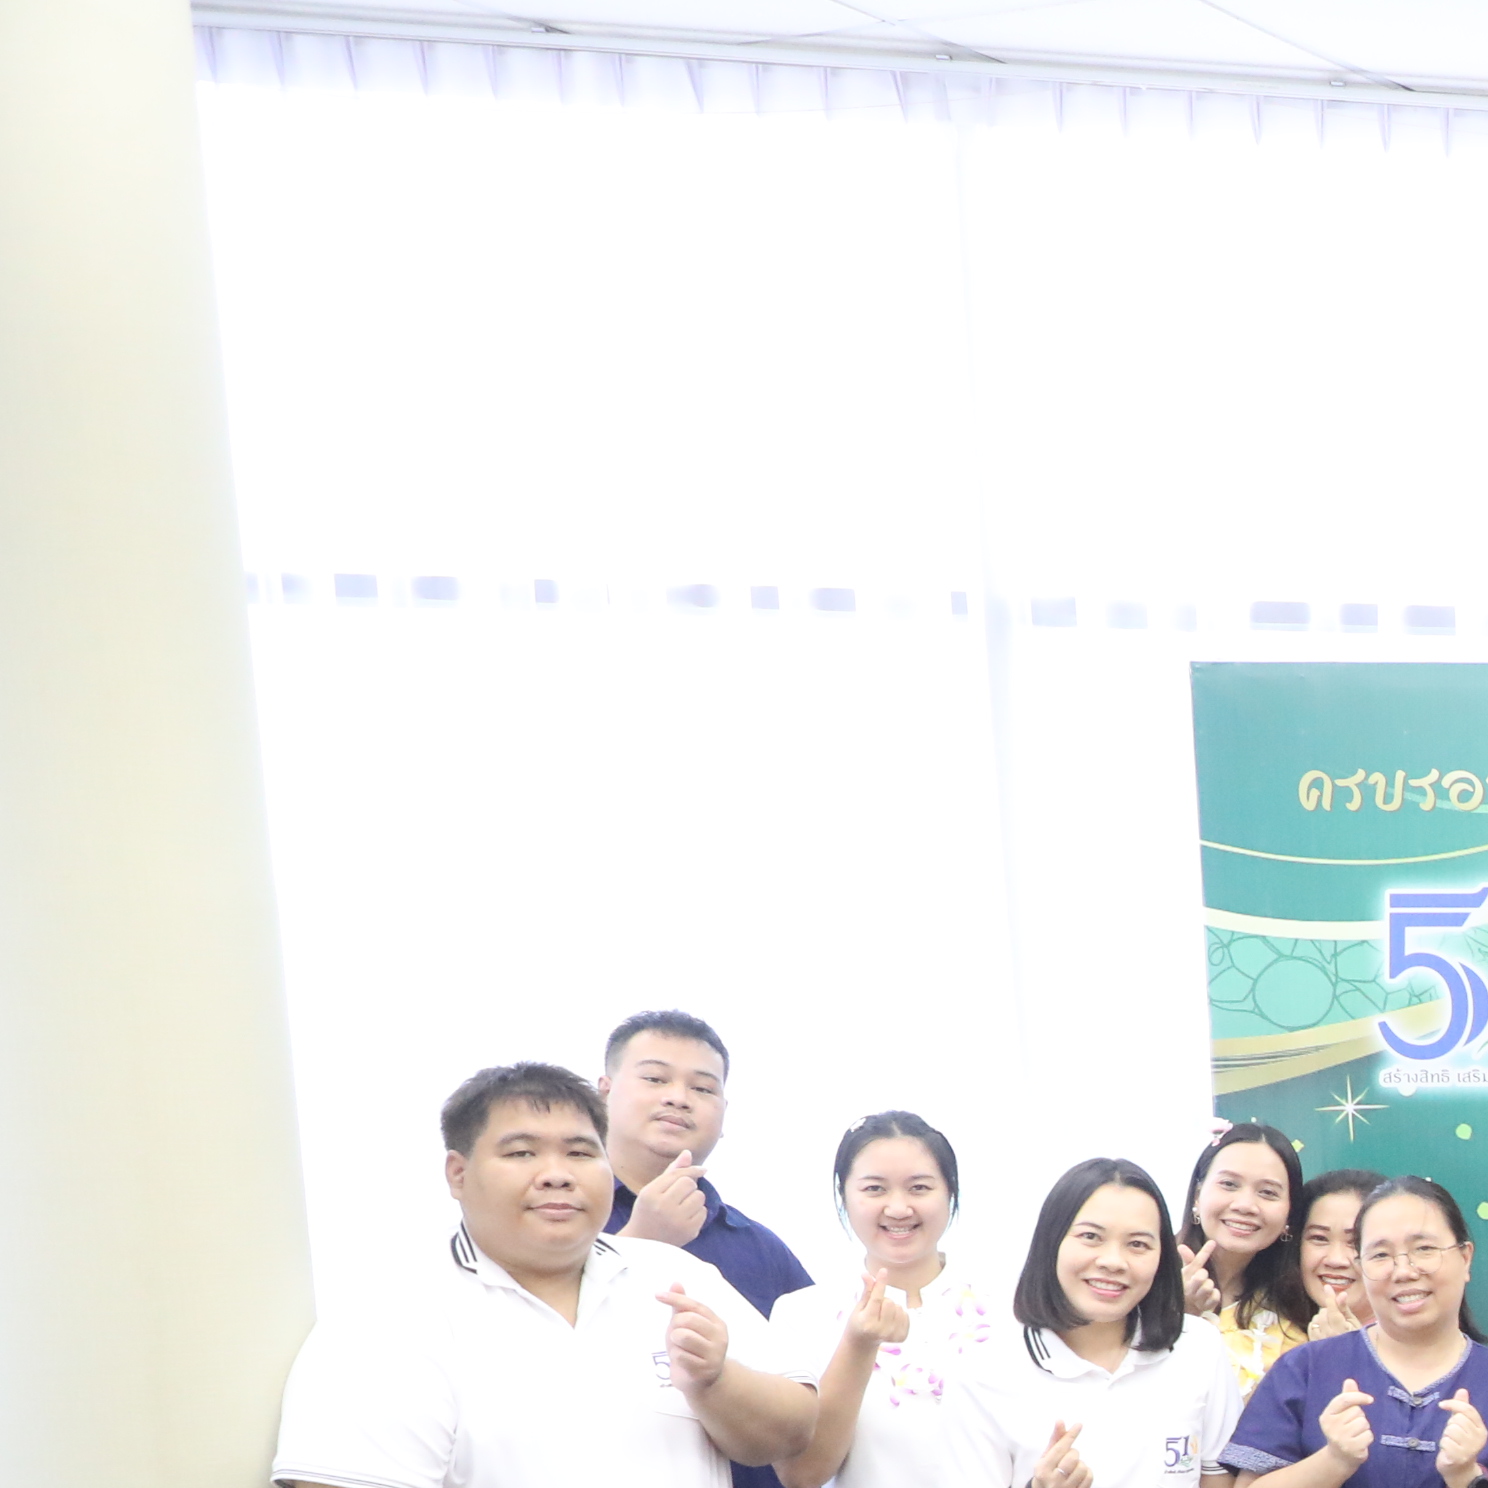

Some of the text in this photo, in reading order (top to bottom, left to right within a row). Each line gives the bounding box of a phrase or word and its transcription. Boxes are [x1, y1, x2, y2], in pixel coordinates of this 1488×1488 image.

[1382, 1068, 1450, 1084] สร้างสิทธิ
[1164, 1434, 1190, 1468] 51
